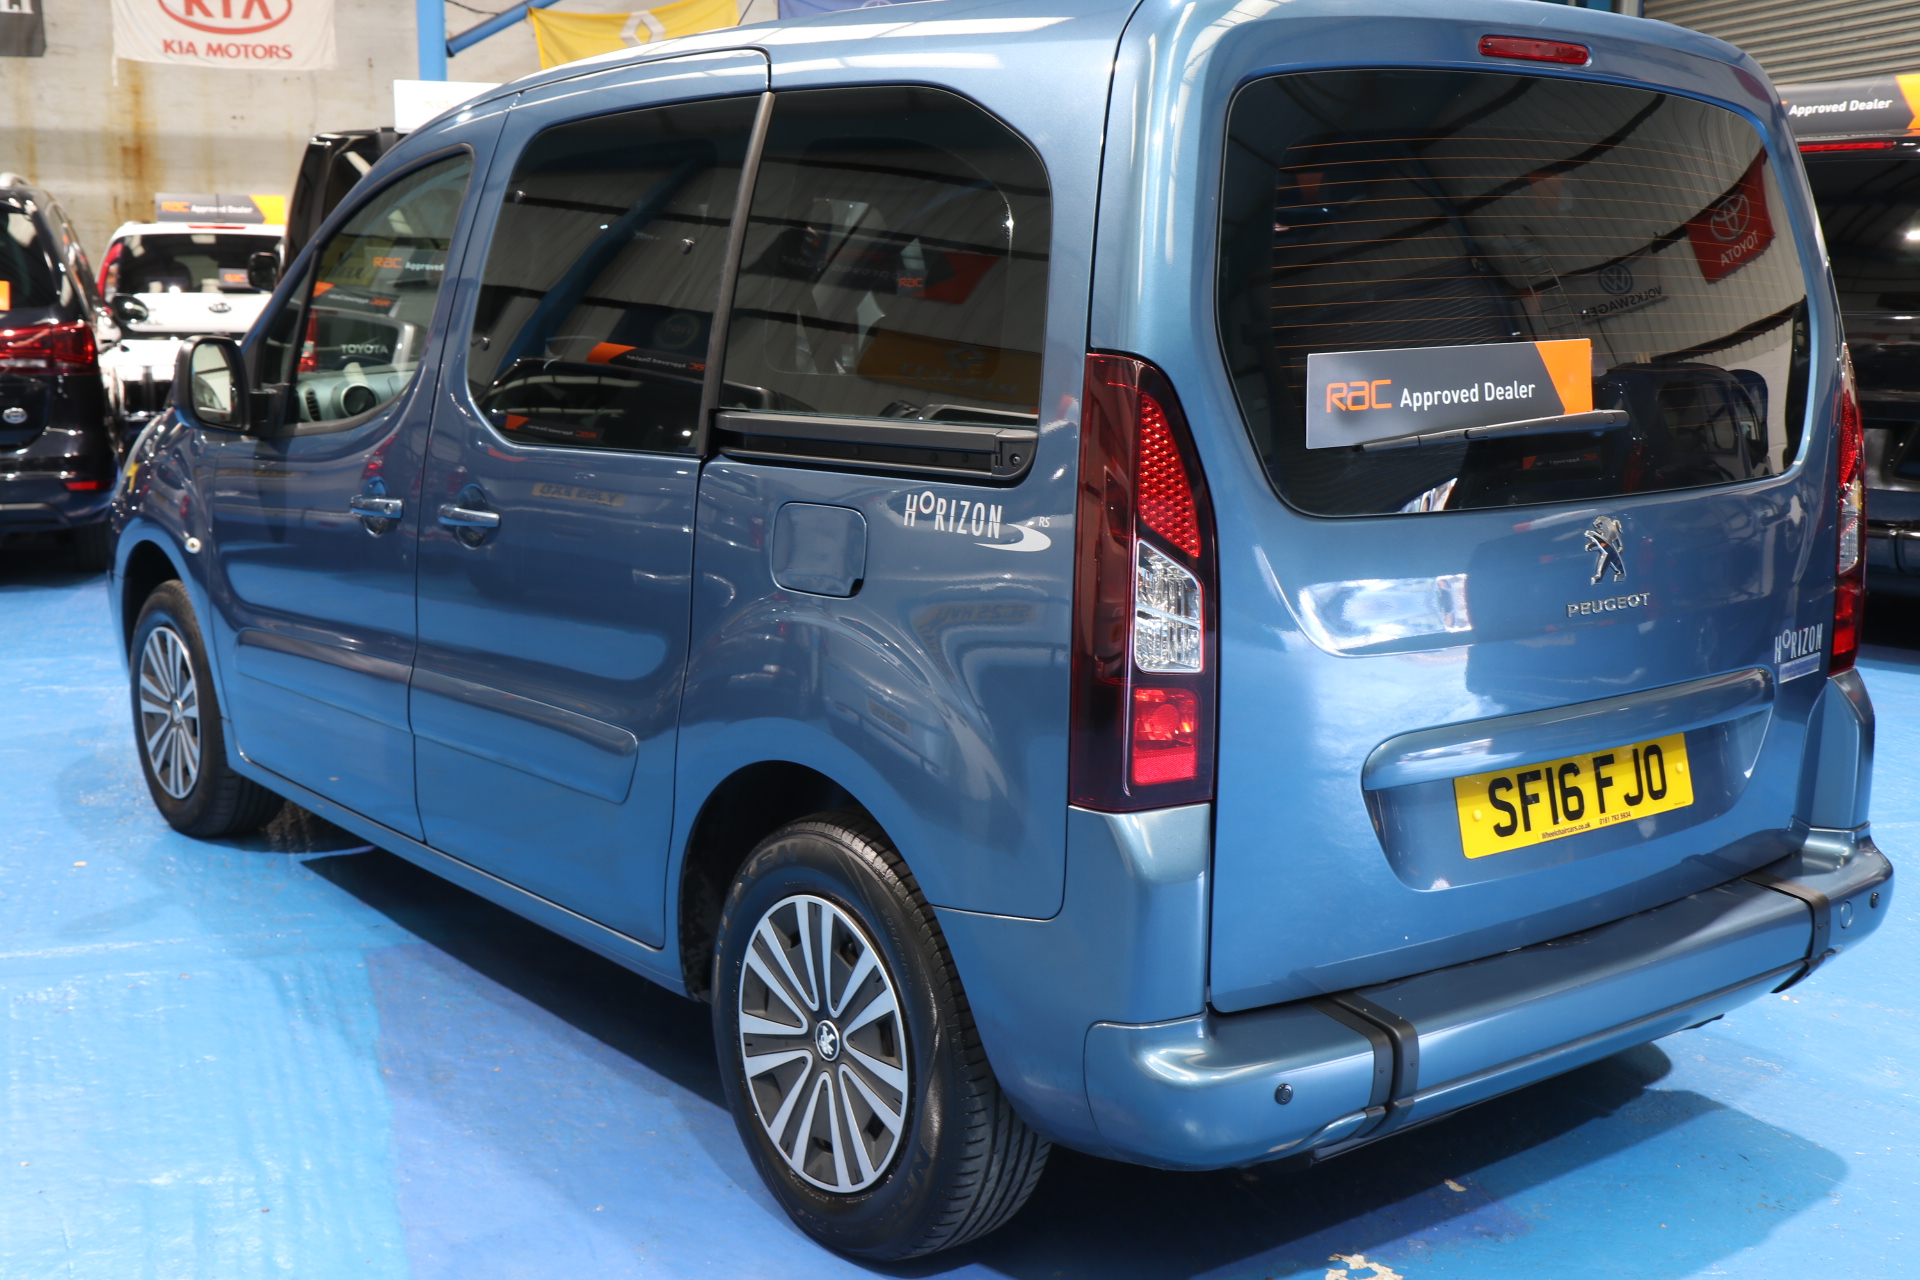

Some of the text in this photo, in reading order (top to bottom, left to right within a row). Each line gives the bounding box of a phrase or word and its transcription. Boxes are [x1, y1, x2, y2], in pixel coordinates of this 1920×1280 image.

[163, 39, 293, 60] KIA MOTORS
[1788, 98, 1894, 118] Approved Dealer
[405, 261, 445, 272] Approved
[341, 343, 389, 354] TOYOTA
[1400, 383, 1479, 412] Approved
[1484, 381, 1536, 402] Dealer
[903, 491, 1003, 539] HORIZON
[1039, 516, 1051, 528] RS
[1566, 592, 1651, 618] PEUGEOT
[1773, 622, 1824, 664] HORIZON
[1487, 762, 1586, 838] SF16
